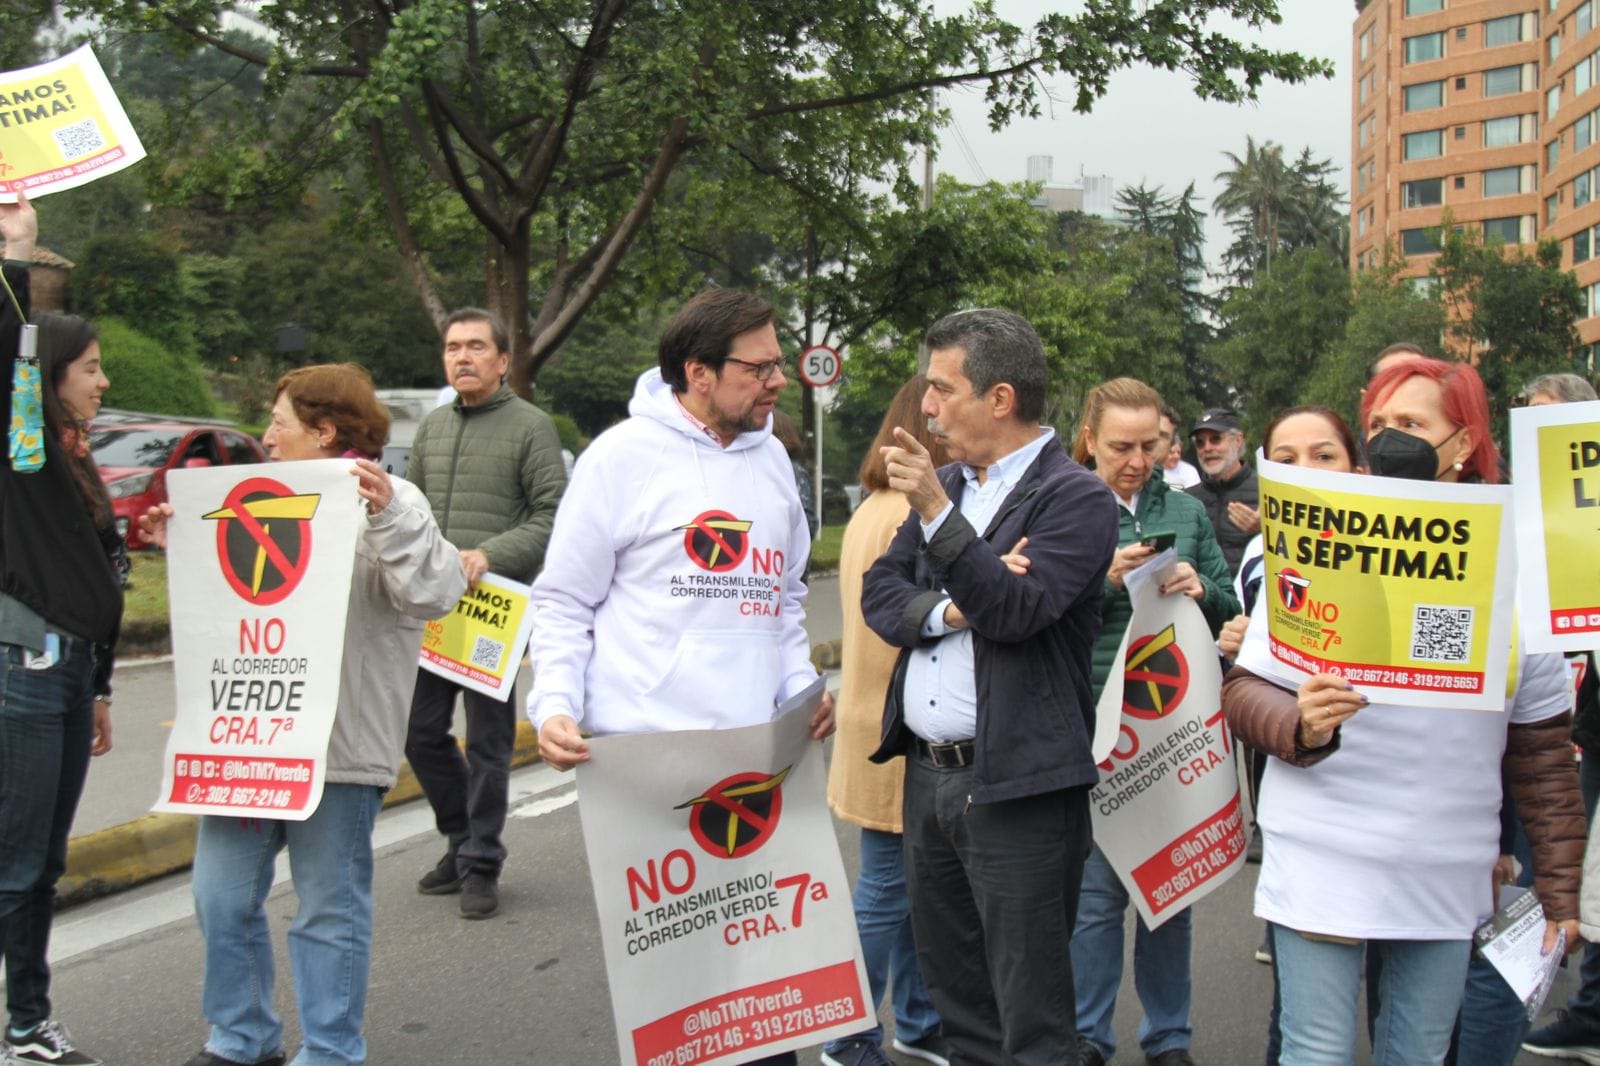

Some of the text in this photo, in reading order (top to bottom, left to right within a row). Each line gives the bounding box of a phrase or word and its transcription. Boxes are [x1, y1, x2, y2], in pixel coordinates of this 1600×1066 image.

[810, 356, 834, 376] 50
[1264, 494, 1470, 545] ¡DEFENDAMOS
[752, 547, 784, 578] NO
[1266, 525, 1468, 582] LA SÉPTIMA!
[670, 575, 774, 588] AL TRANSMILENIO/
[671, 587, 773, 601] CORREDOR VERDE
[428, 620, 443, 634] NO
[1307, 599, 1339, 623] NO
[239, 617, 286, 655] NO
[212, 657, 308, 675] AL CORREDOR
[1344, 667, 1362, 681] 302
[1364, 669, 1383, 682] 667
[1384, 671, 1408, 684] 2146
[1414, 674, 1433, 687] 319
[1434, 675, 1452, 688] 278
[1453, 676, 1478, 689] 5653
[210, 679, 306, 711] VERDE
[223, 760, 310, 783] @NoTM7verde
[1089, 715, 1203, 804] AL TRANSMILENIO/
[1099, 730, 1215, 816] CORREDOR VERDE
[1177, 750, 1226, 785] CRA.
[206, 785, 292, 807] 302 667-2146
[626, 849, 696, 911] NO
[1151, 881, 1177, 907] 302
[1170, 866, 1196, 893] 667
[1193, 847, 1228, 879] 2146
[624, 871, 773, 937] AL TRANSMILENIO/
[627, 891, 779, 956] CORREDOR VERDE
[724, 913, 787, 945] CRA.
[684, 985, 803, 1036] @NoTM7verde
[675, 1038, 702, 1066] 667
[704, 1026, 744, 1056] 2146
[752, 1018, 783, 1041] 319
[785, 1008, 814, 1035] 278
[815, 996, 855, 1025] 5653
